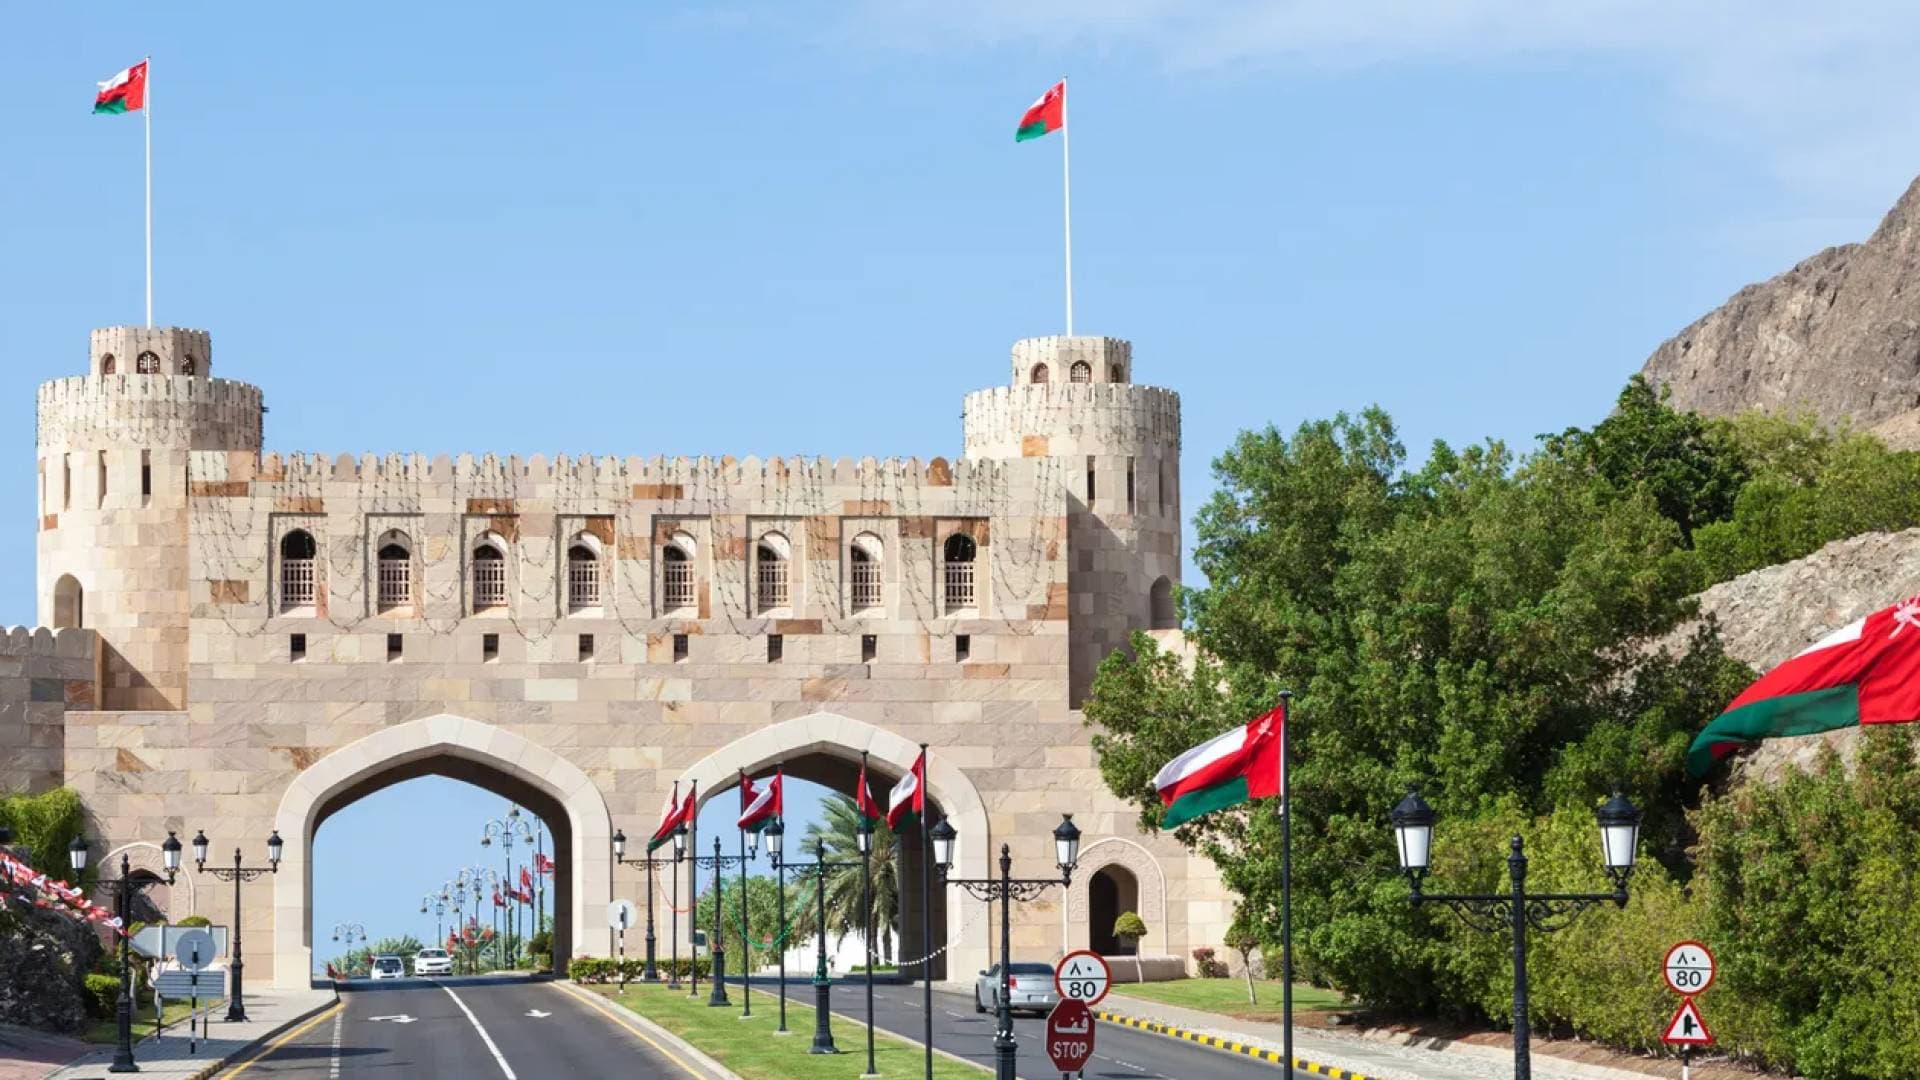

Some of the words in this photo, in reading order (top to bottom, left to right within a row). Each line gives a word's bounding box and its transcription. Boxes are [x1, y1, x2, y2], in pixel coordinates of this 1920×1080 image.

[1675, 970, 1702, 987] 80
[1069, 981, 1096, 998] 80
[1054, 1010, 1089, 1034] قف
[1053, 1041, 1088, 1058] STOP
